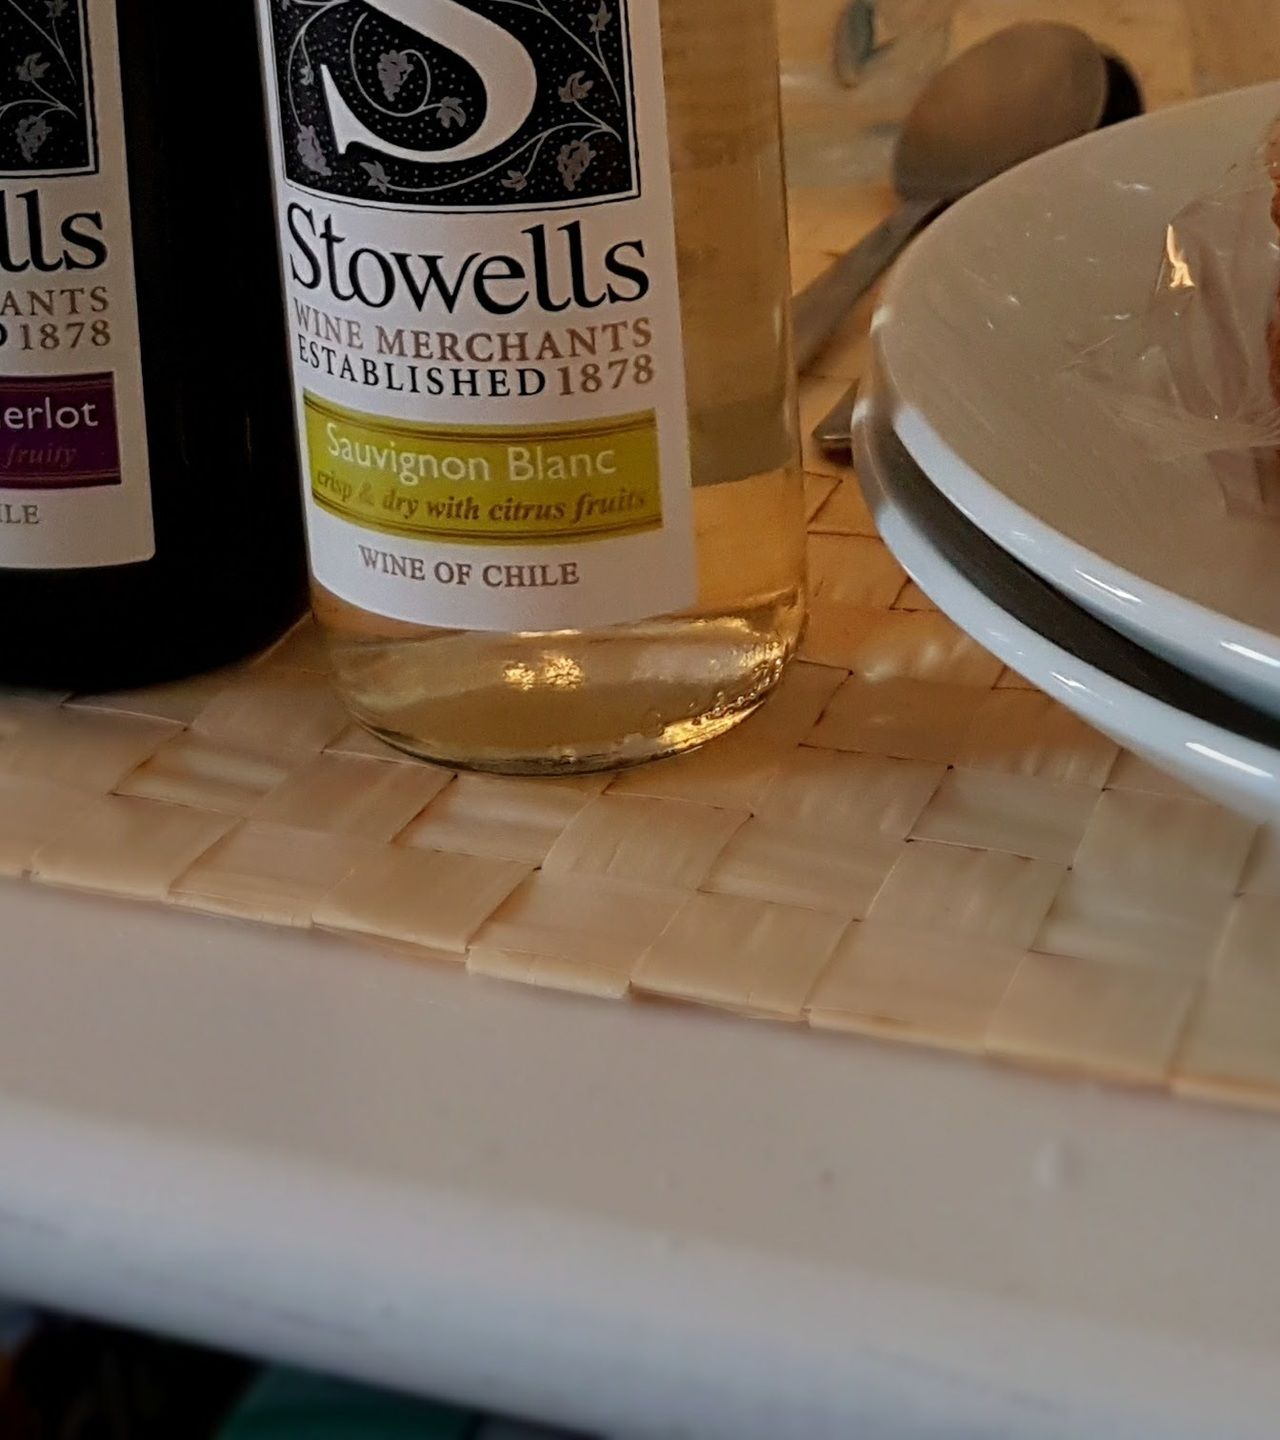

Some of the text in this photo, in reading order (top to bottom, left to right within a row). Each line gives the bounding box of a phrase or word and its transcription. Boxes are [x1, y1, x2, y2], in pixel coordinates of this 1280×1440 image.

[287, 202, 650, 314] Stowells
[21, 319, 111, 351] 1878
[293, 297, 652, 361] WINE MERCHANTS
[297, 333, 654, 397] ESTABLISHED 1878
[3, 442, 77, 469] fruity
[325, 422, 616, 486] Sauvignon Blanc
[316, 468, 646, 525] crisp & dry with citrus fruits
[357, 544, 581, 588] WINE OF CHILE
